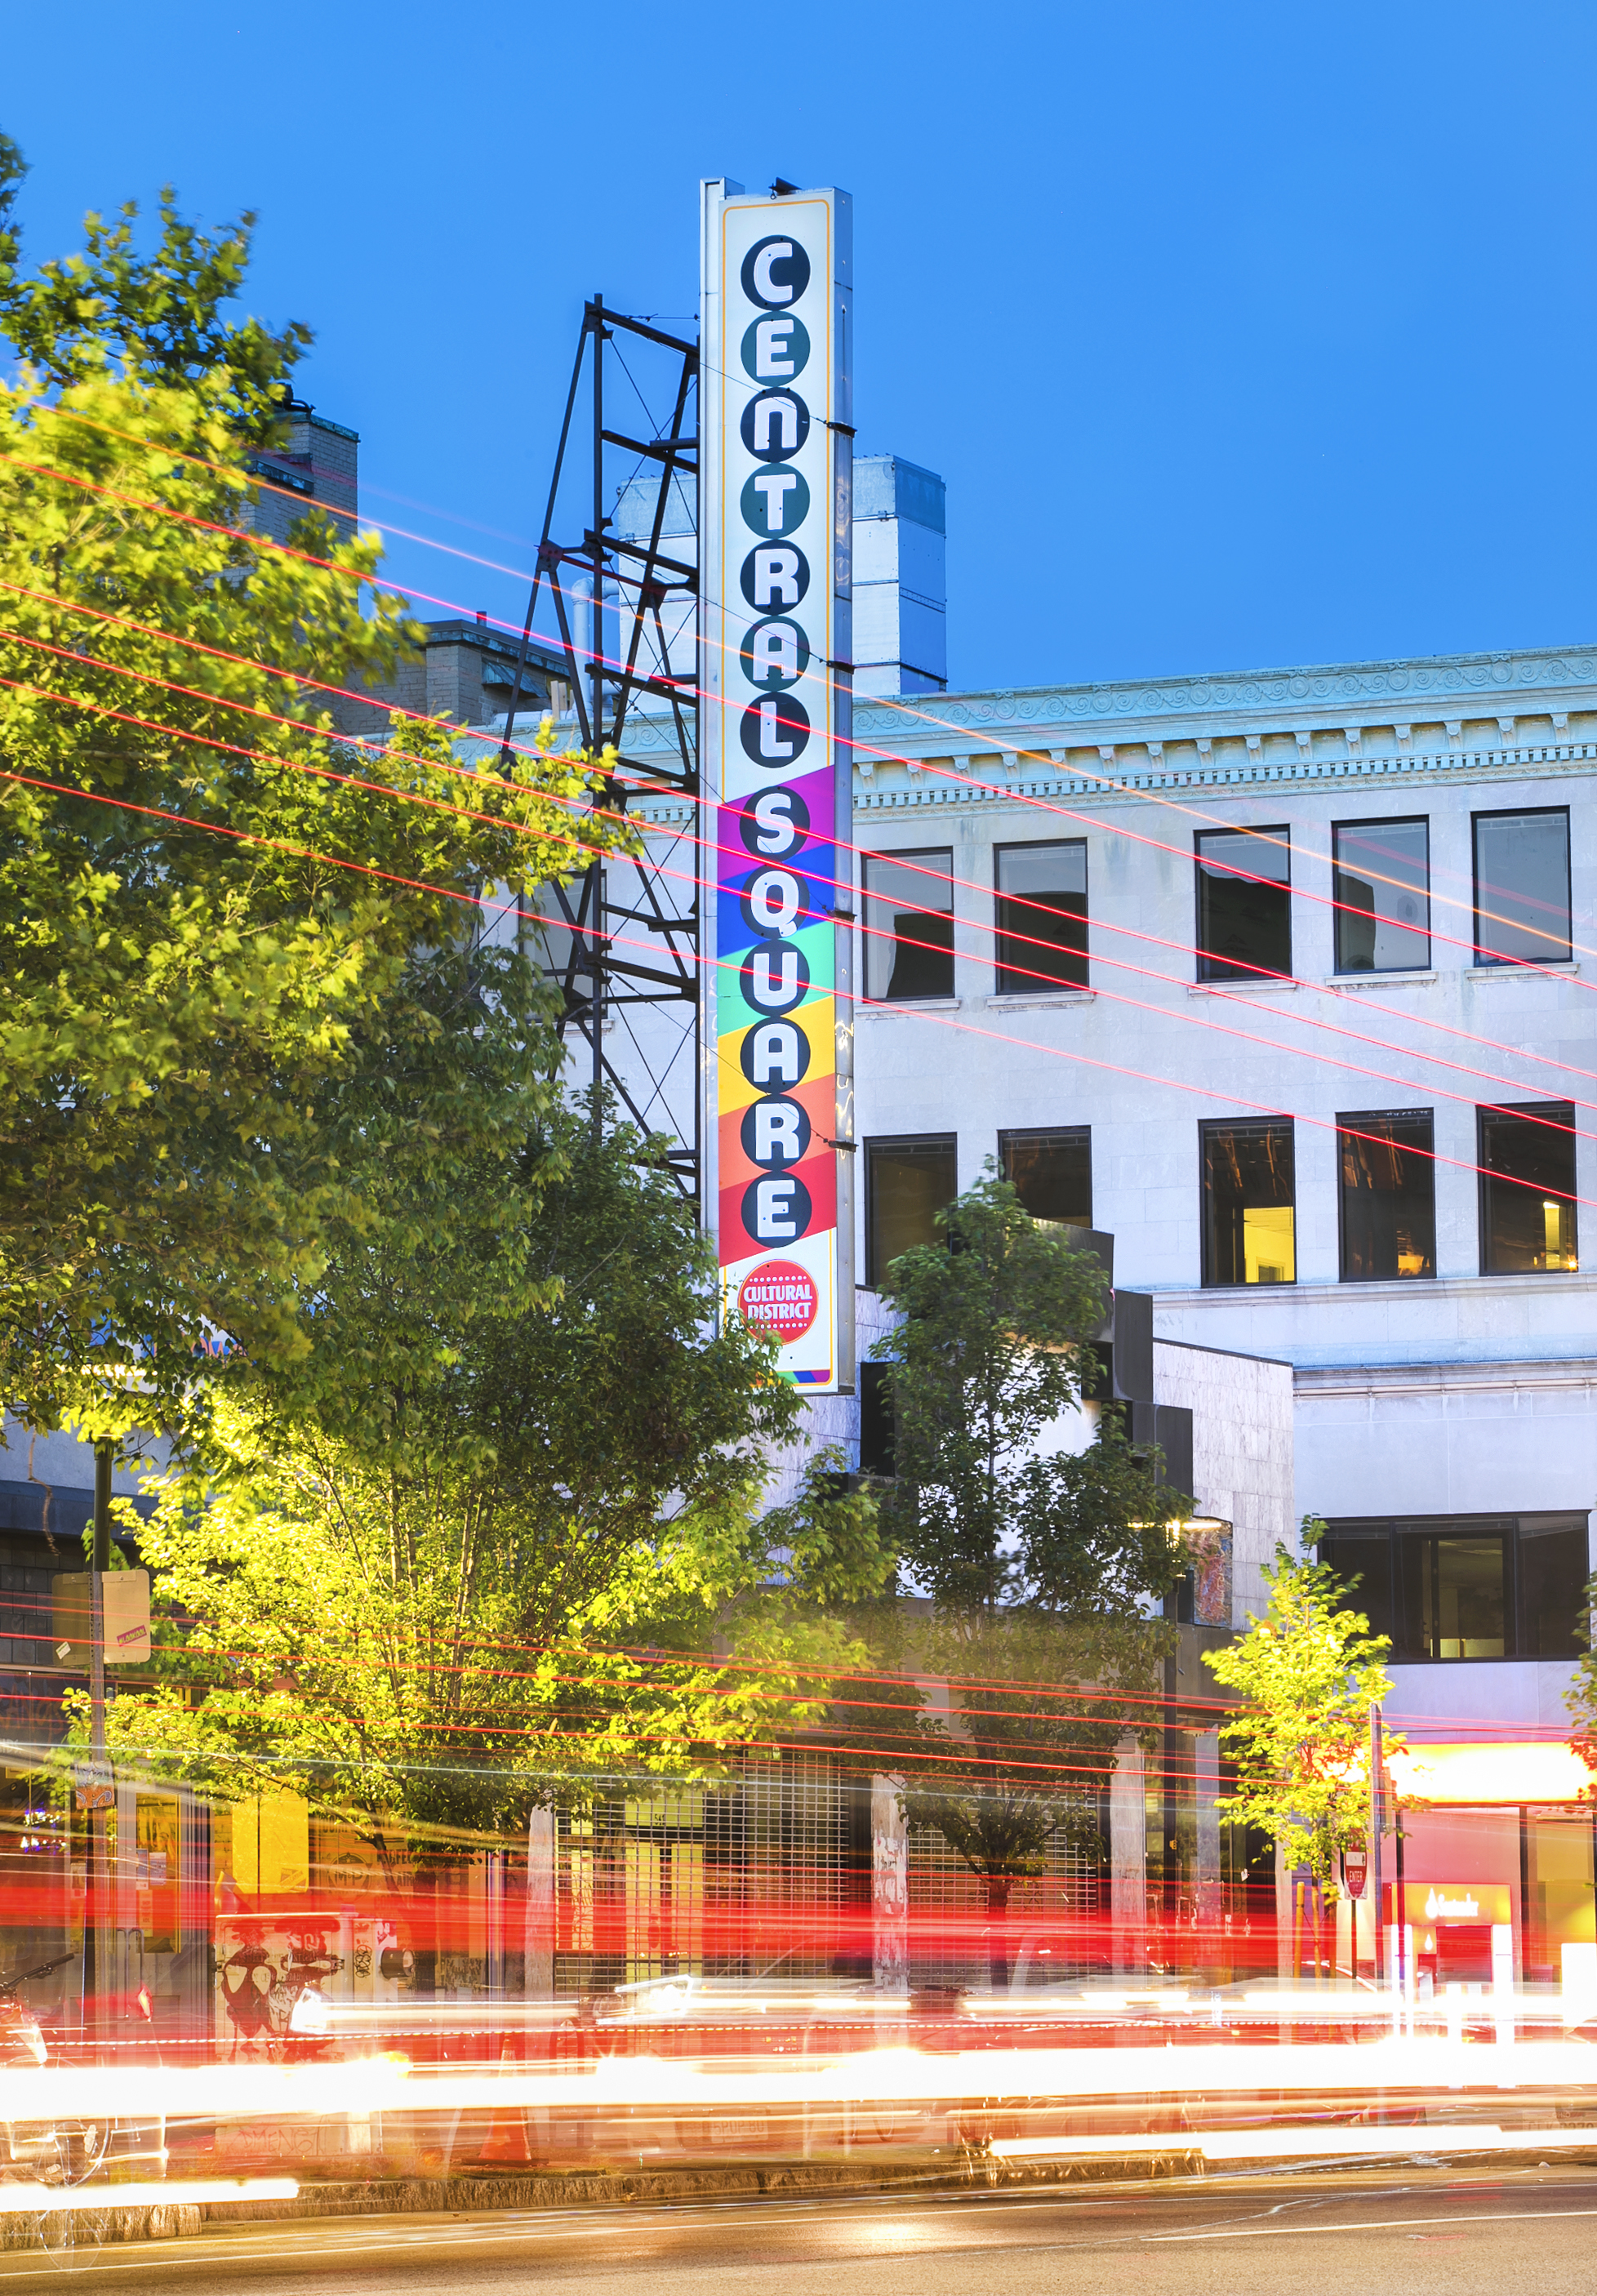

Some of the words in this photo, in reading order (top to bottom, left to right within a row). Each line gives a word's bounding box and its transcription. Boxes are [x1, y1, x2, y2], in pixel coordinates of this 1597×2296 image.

[753, 243, 799, 758] CENTRAL
[749, 792, 801, 1238] SQUARE
[744, 1284, 812, 1303] CULTURAL
[748, 1302, 812, 1320] DISTRICT
[1350, 1870, 1363, 1884] ENTER
